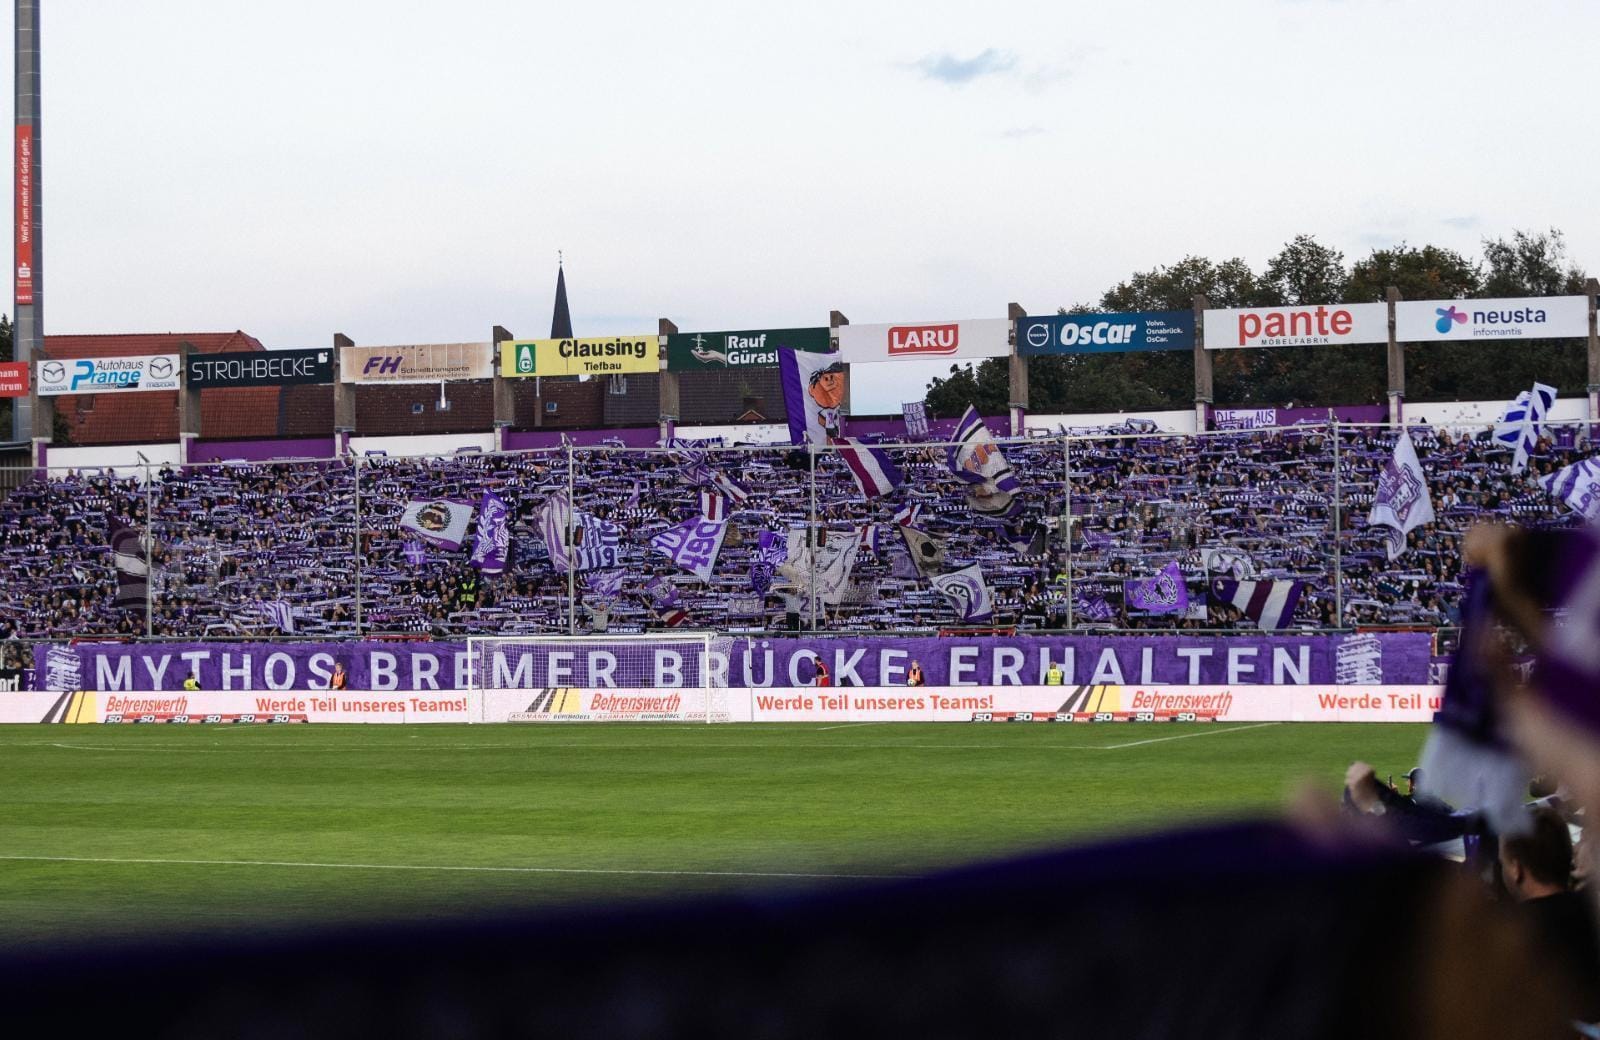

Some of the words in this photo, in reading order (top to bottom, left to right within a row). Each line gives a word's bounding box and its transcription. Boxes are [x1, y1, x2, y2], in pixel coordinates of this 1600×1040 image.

[21, 157, 29, 174] Geld
[21, 175, 29, 186] als
[21, 188, 29, 207] mehr
[23, 208, 29, 220] um
[21, 222, 29, 243] Weil's
[1473, 307, 1547, 325] neusta
[1145, 327, 1184, 335] Osnabrück.
[1238, 306, 1353, 346] pante
[1473, 328, 1523, 337] infomantis
[727, 334, 767, 349] Rauf
[892, 329, 954, 349] LARU
[1261, 337, 1329, 346] MÖBELFABRIK
[559, 338, 646, 359] Clausing
[95, 360, 144, 370] Autohaus
[191, 357, 315, 381] STROHBECKE
[363, 356, 403, 374] FH
[583, 361, 622, 371] Tiefbau
[70, 360, 141, 391] Prange
[1255, 410, 1274, 424] AUS
[95, 650, 336, 691] MYTHOS
[370, 650, 618, 690] BREMER
[653, 641, 909, 688] BRÜCKE
[950, 645, 1310, 686] ERHALTEN
[106, 695, 188, 715] Behrenswerth
[256, 698, 305, 712] Werde
[310, 698, 337, 712] Teil
[342, 700, 405, 713] unseres
[409, 697, 468, 712] Teams!
[590, 692, 681, 712] Behrenswerth
[756, 694, 813, 710] Werde
[818, 695, 848, 710] Teil
[854, 696, 925, 710] unseres
[930, 694, 994, 709] Teams!
[1131, 690, 1233, 716] Behrenswerth
[1318, 694, 1382, 709] Werde
[1387, 693, 1421, 709] Teil
